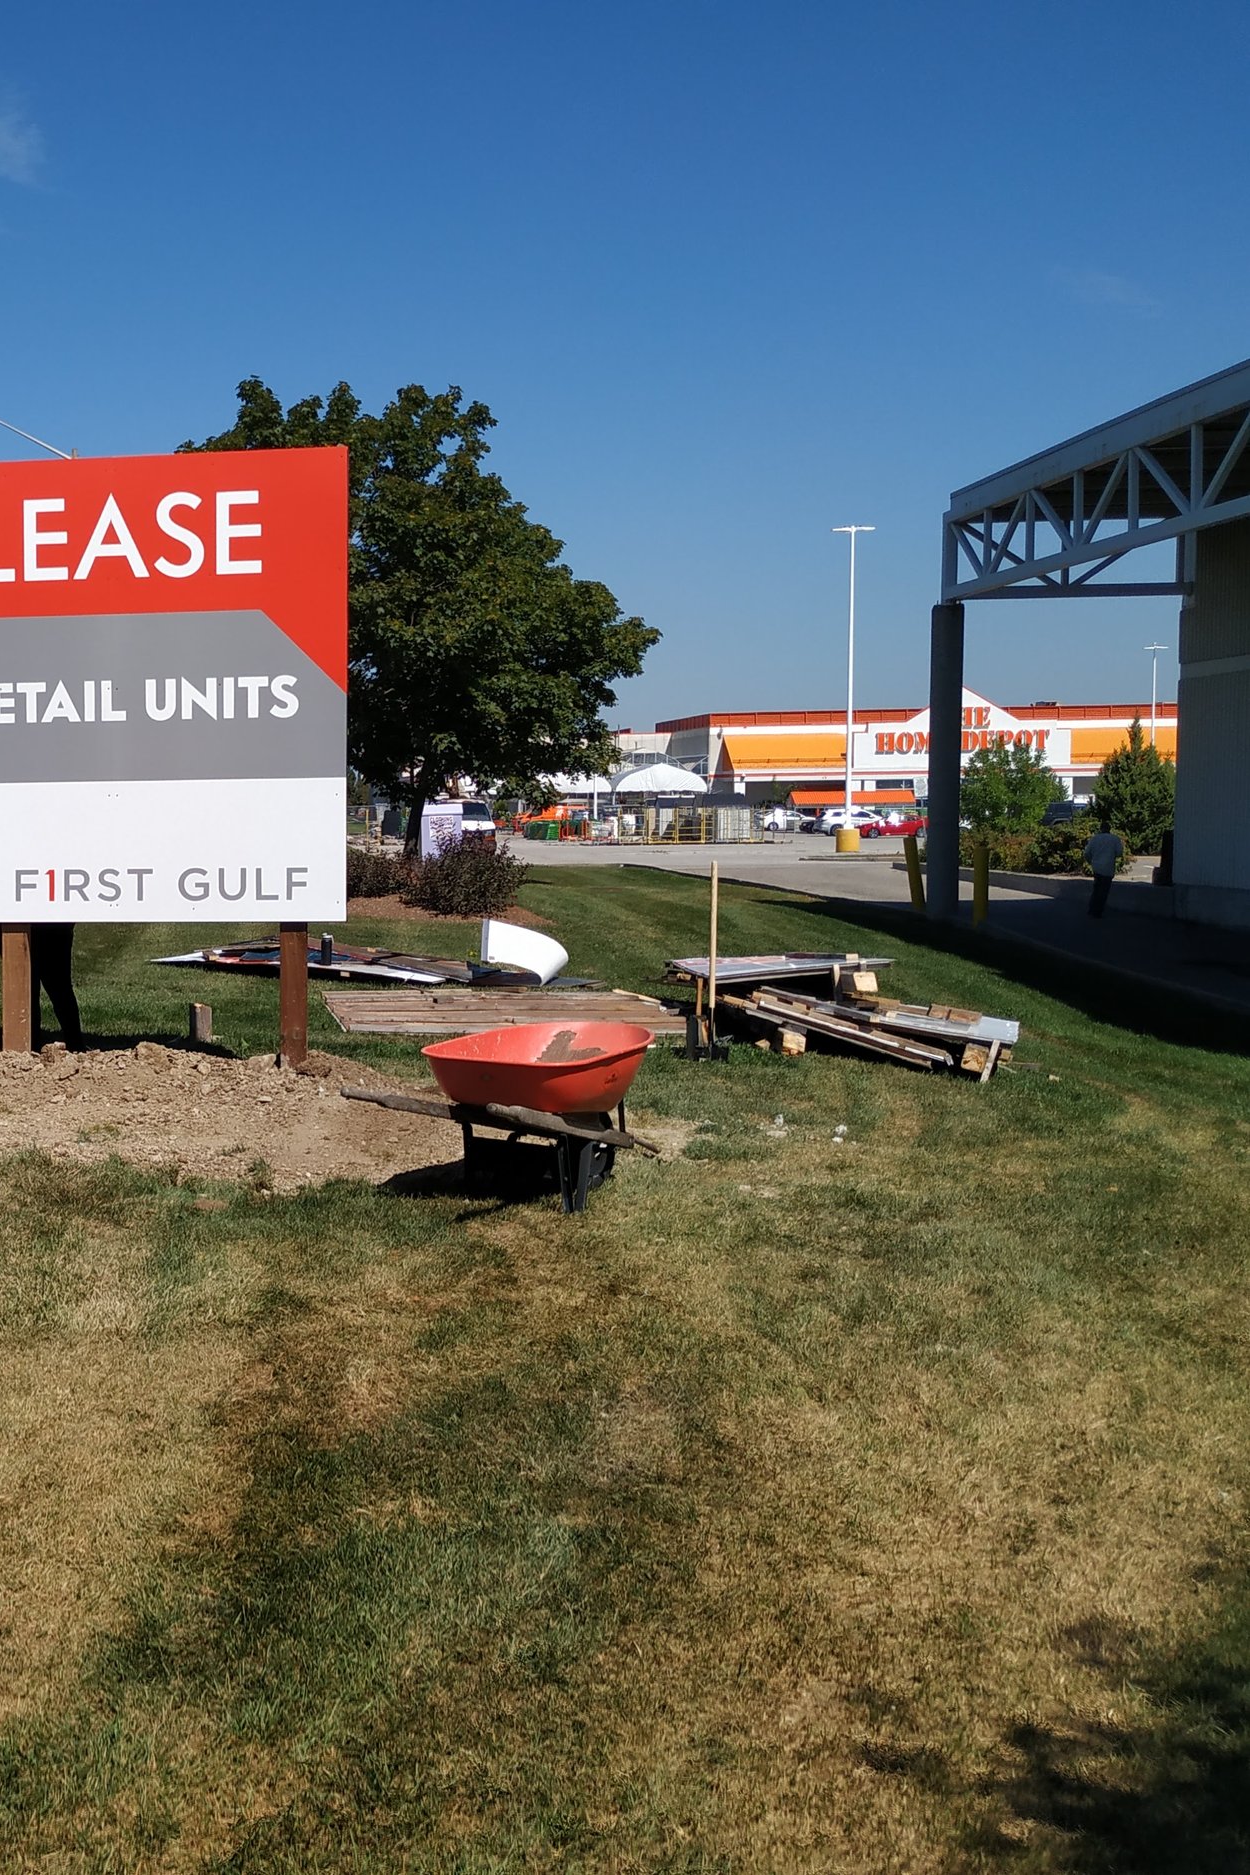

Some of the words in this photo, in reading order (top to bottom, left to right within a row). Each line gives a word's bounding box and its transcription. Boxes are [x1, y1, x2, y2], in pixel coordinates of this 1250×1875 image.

[145, 674, 300, 721] UNITS
[875, 731, 930, 755] HOM
[961, 728, 1050, 754] DEPOT
[177, 867, 308, 902] GULF
